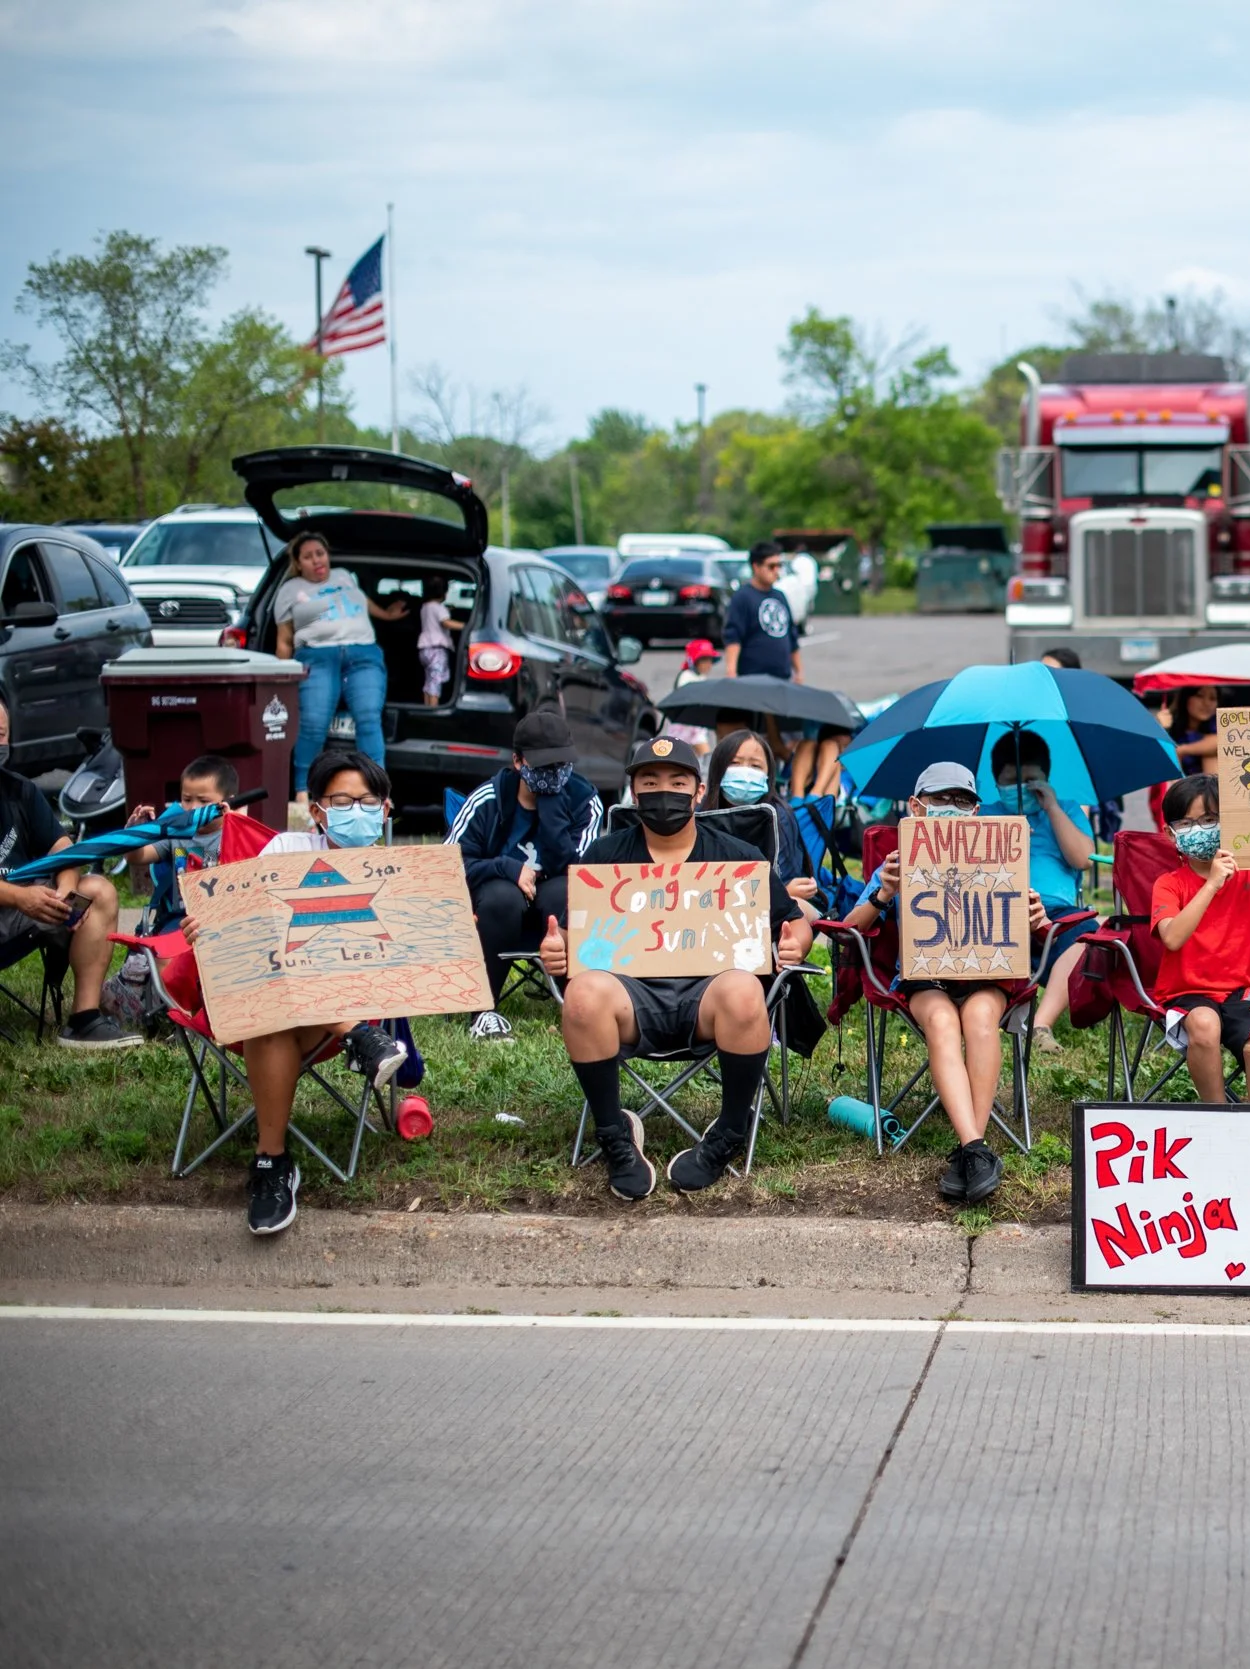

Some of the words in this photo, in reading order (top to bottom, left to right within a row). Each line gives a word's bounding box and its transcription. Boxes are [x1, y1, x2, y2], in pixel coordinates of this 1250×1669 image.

[908, 820, 1022, 866] AMAZING
[199, 870, 280, 898] You're
[363, 861, 402, 879] Star
[610, 877, 761, 913] Congrats!
[645, 920, 709, 952] Suni
[910, 890, 1022, 948] SUNI
[268, 950, 312, 972] Suni
[341, 942, 386, 962] Lee!
[1090, 1121, 1193, 1189] Pik
[1090, 1191, 1238, 1269] Ninja
